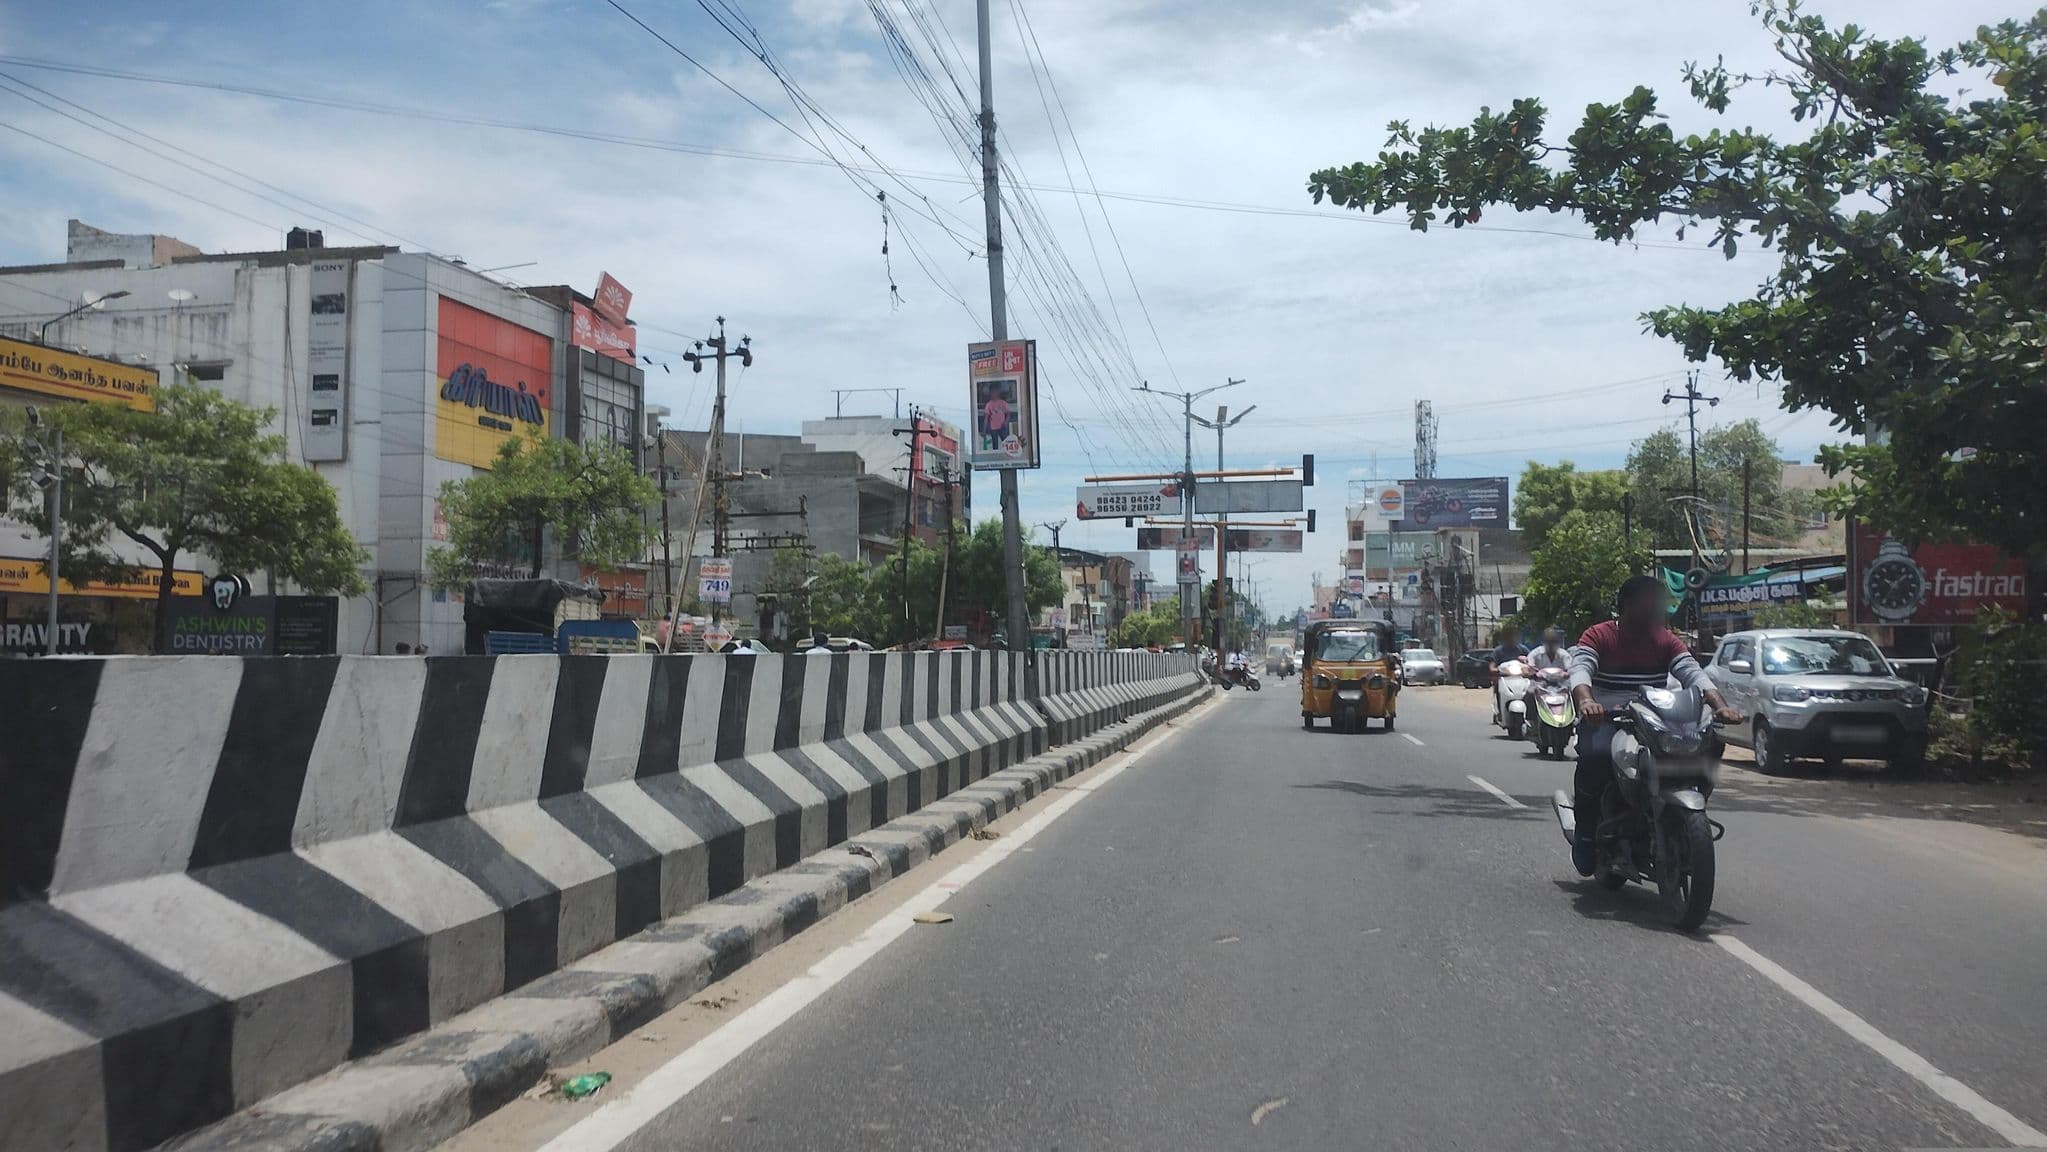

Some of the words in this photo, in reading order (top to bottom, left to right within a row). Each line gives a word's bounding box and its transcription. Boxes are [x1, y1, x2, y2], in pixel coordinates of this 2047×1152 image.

[313, 264, 345, 272] SONY
[706, 580, 729, 592] 749
[175, 615, 267, 633] ASHWIN'S
[0, 622, 92, 647] RAVITY
[173, 634, 267, 649] DENTISTRY
